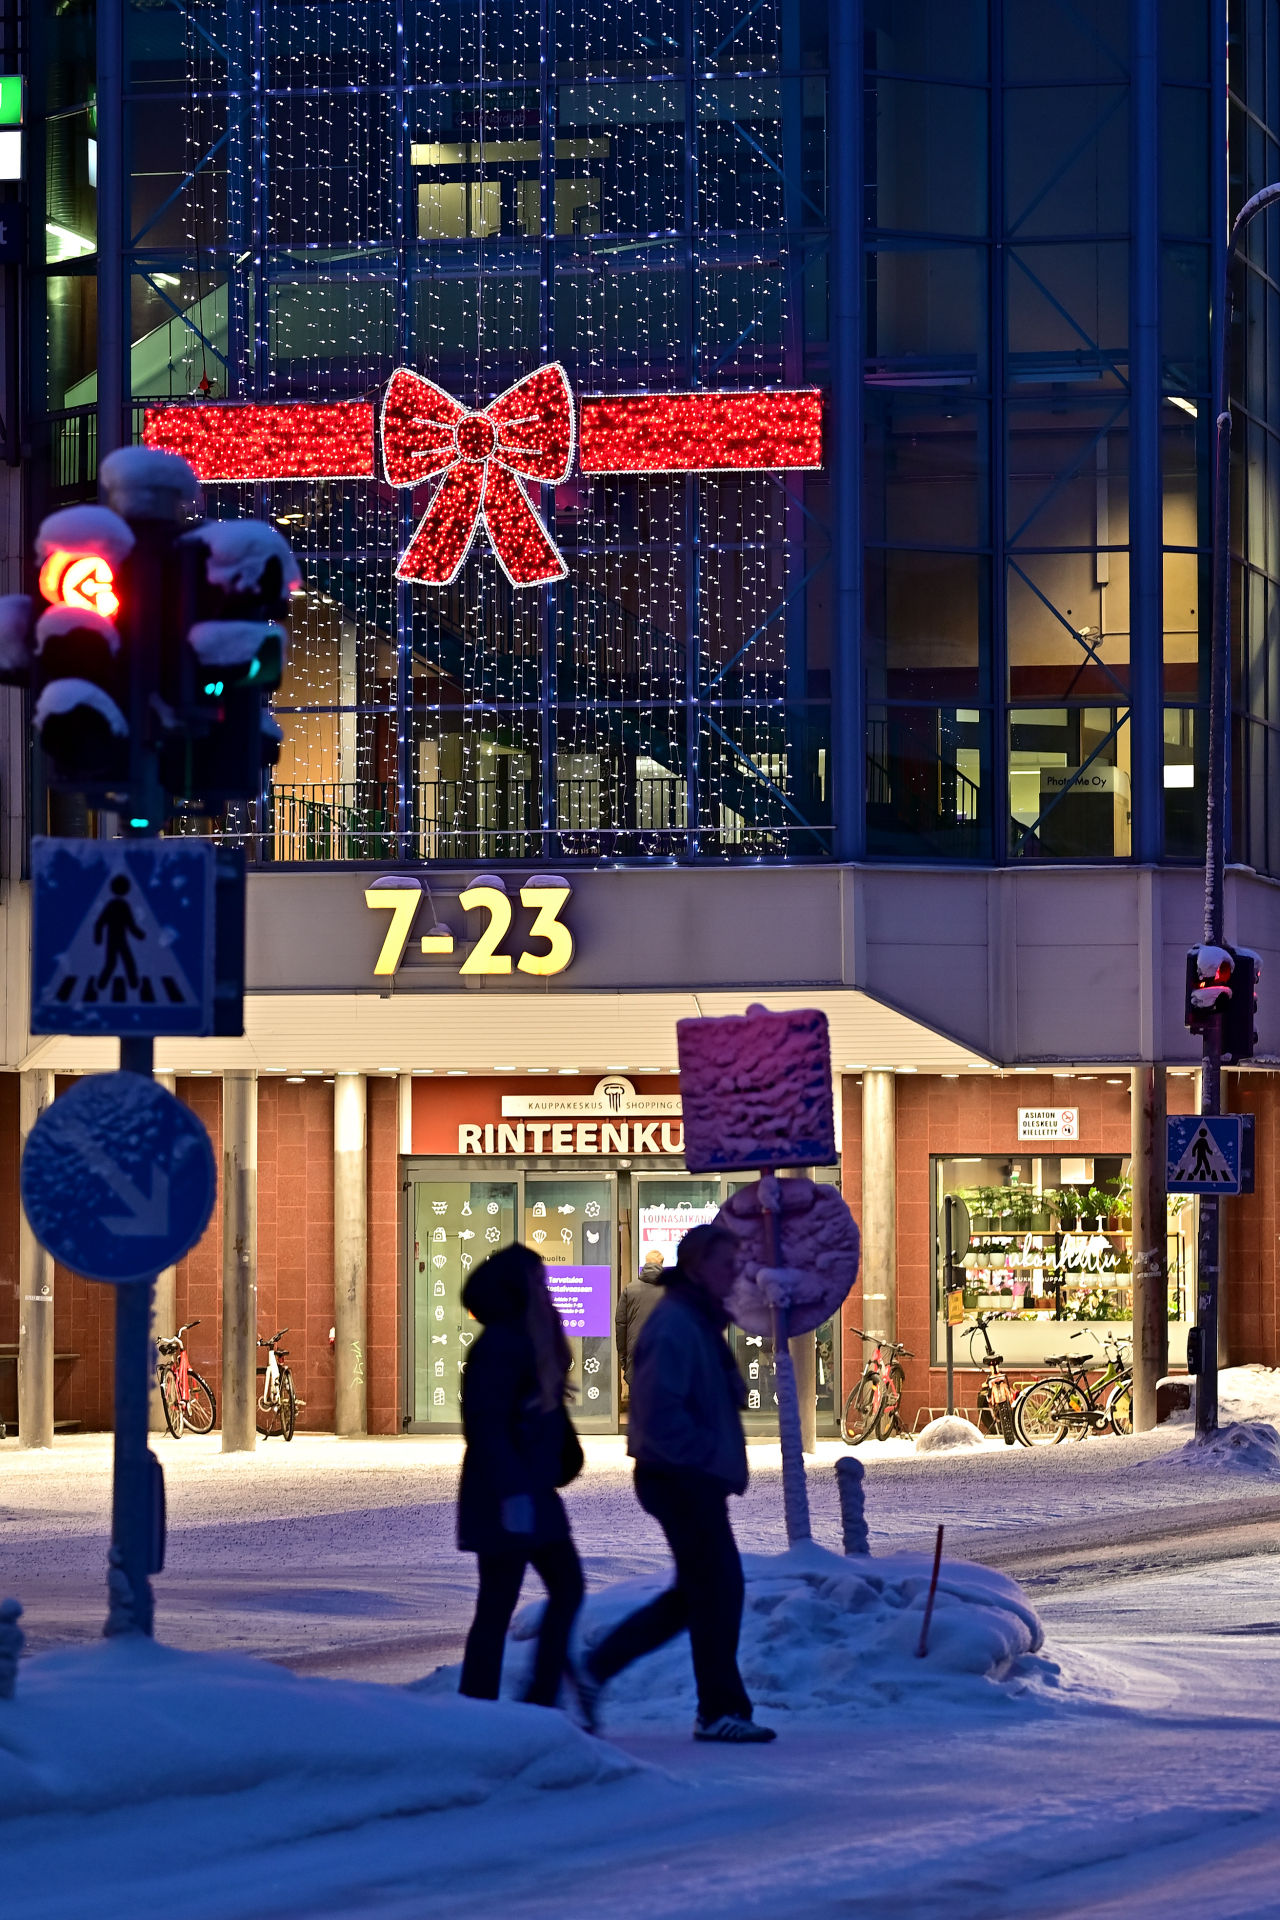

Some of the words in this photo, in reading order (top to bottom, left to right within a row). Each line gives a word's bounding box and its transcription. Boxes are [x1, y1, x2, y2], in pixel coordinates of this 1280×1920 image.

[1047, 776, 1070, 785] Phot
[1092, 776, 1106, 787] Oy
[364, 886, 573, 975] 7-23
